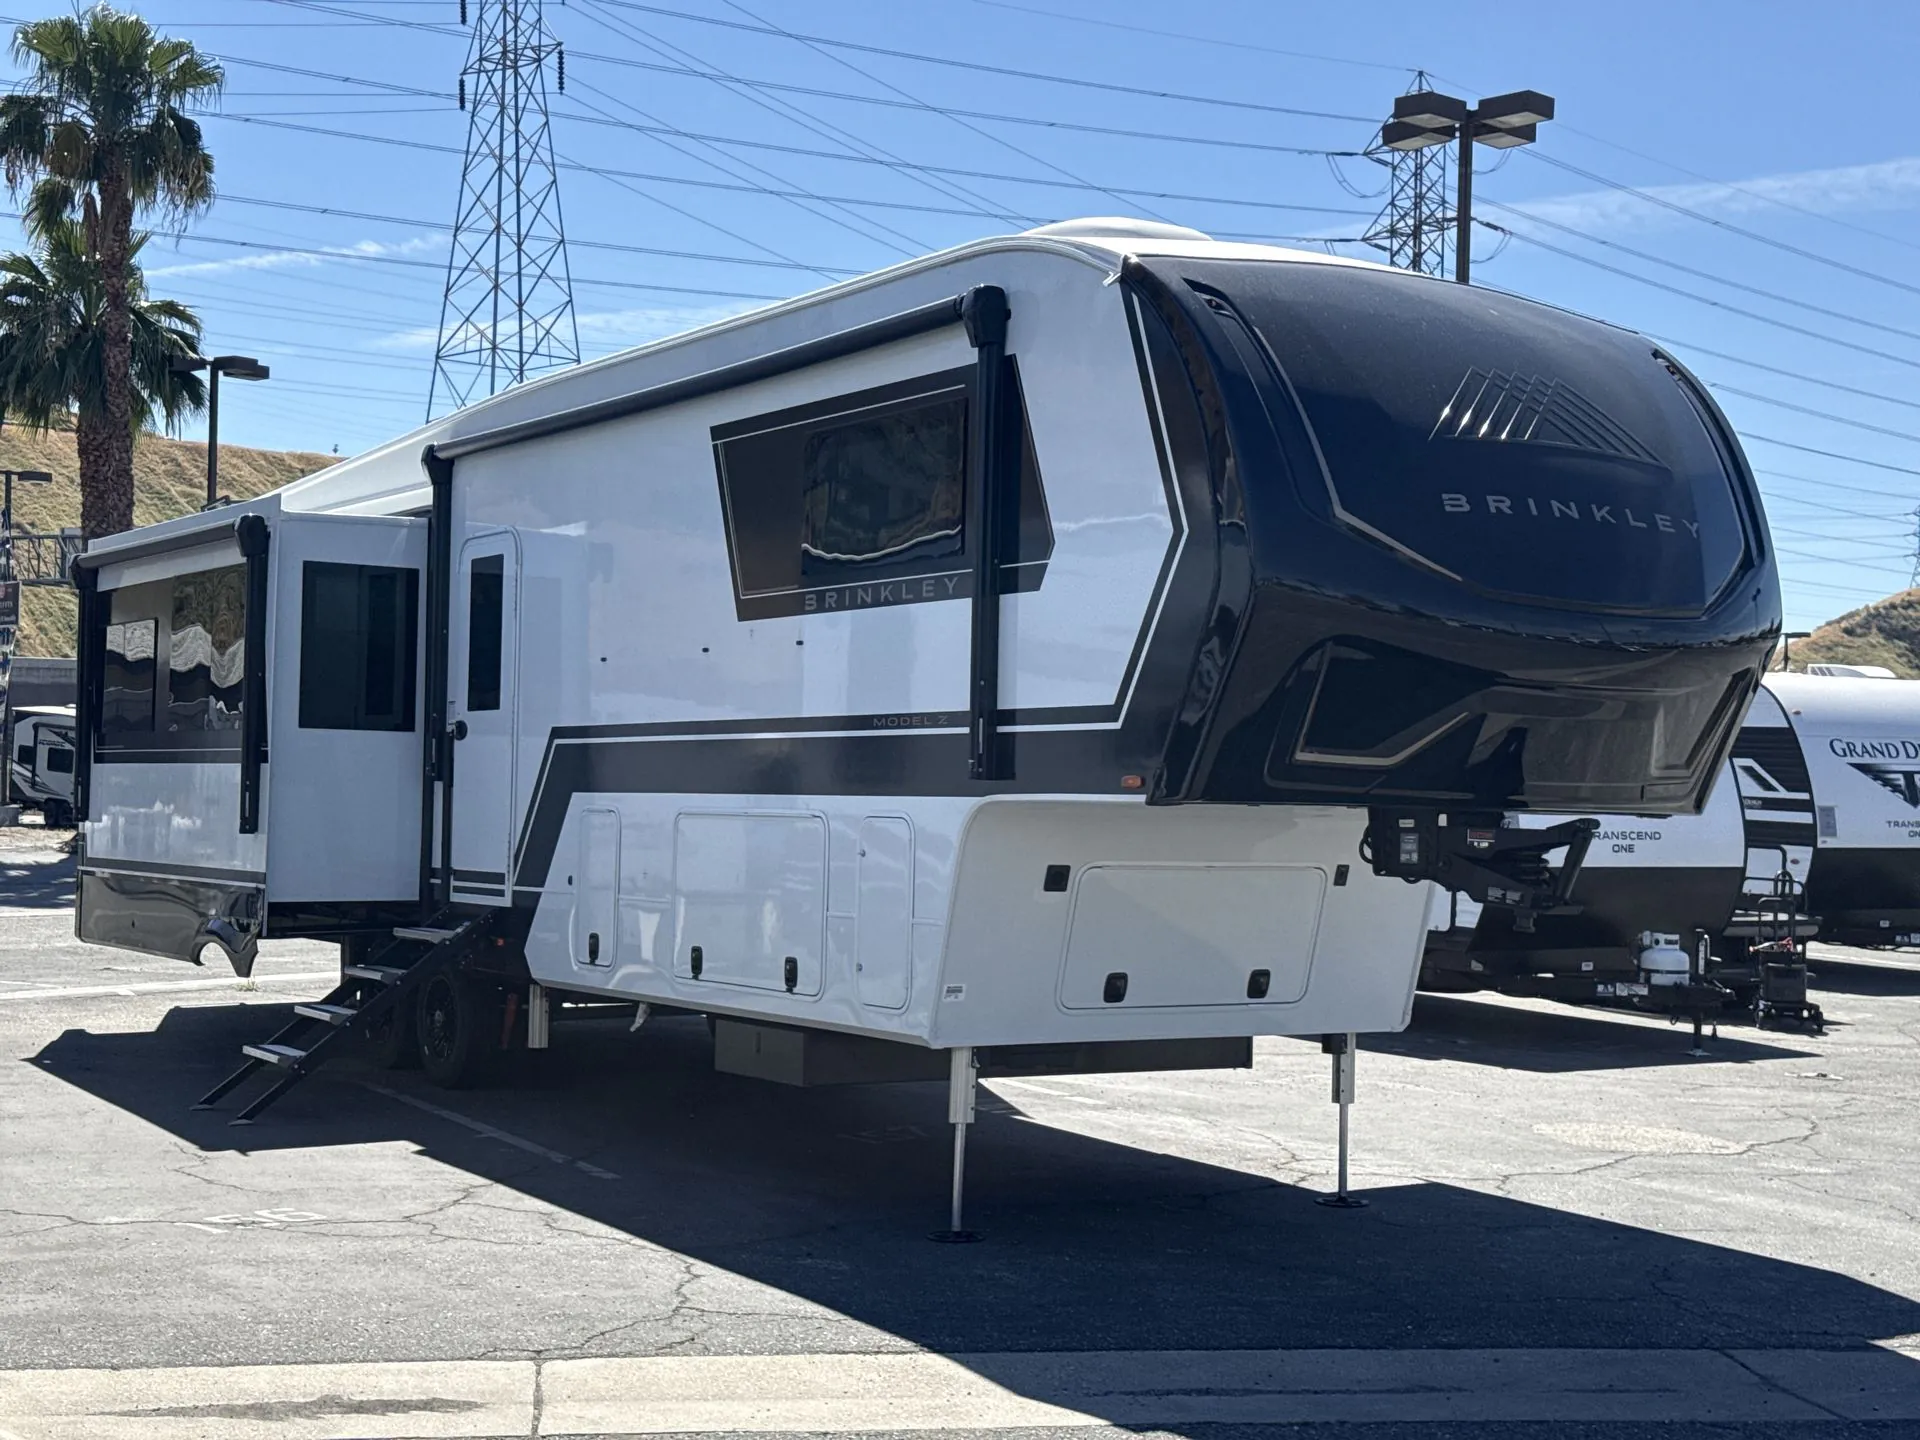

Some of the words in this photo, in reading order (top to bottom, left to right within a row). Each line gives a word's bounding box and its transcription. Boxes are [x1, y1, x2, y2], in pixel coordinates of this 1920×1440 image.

[1441, 493, 1700, 538] BRINKLEY
[804, 576, 960, 611] BRINKLEY
[873, 715, 932, 727] MODEL
[938, 714, 948, 725] Z
[1829, 737, 1900, 759] GRAND
[1900, 740, 1920, 759] D
[1592, 831, 1662, 841] RANSCEND
[1612, 844, 1635, 853] ONE
